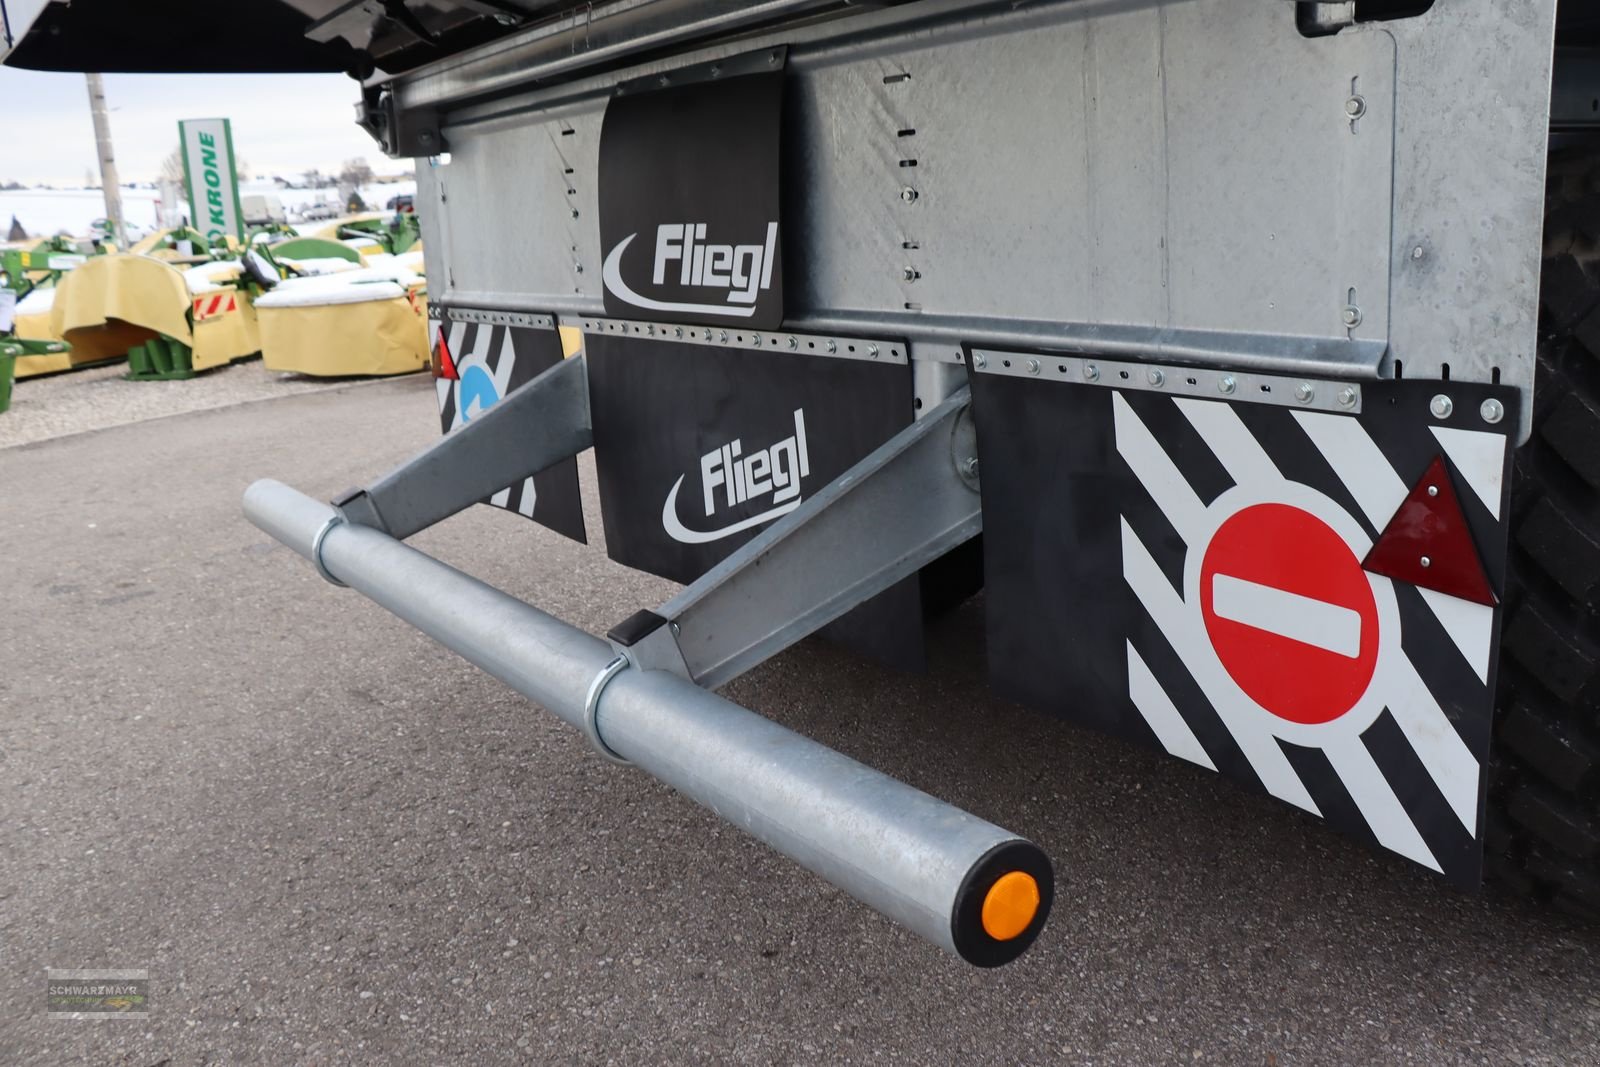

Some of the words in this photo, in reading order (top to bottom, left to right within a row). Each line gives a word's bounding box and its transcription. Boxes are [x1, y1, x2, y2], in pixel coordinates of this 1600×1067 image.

[198, 131, 226, 227] KRONE
[653, 222, 778, 303] Fliegl
[700, 407, 810, 516] Fliegl
